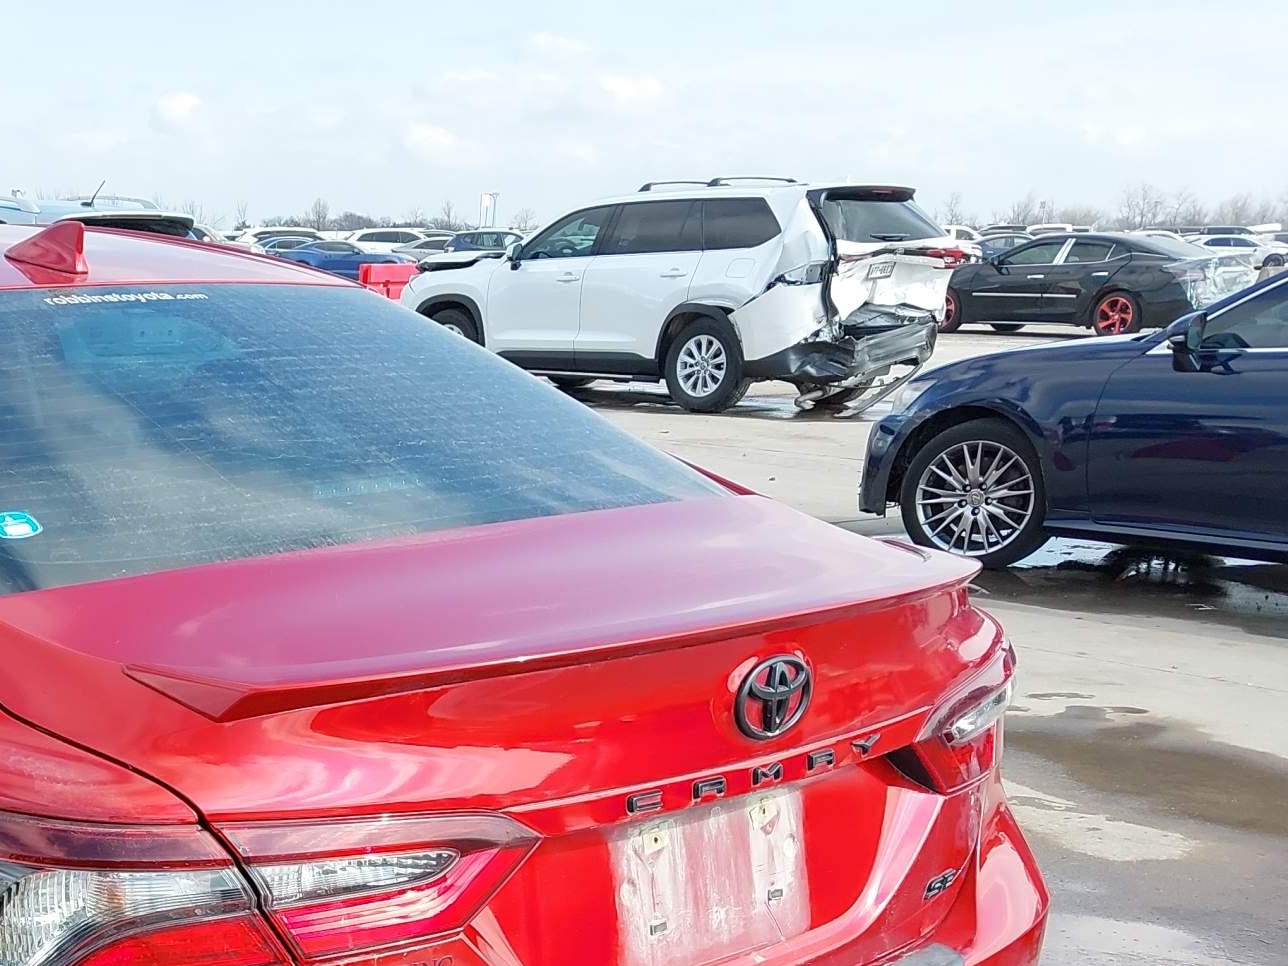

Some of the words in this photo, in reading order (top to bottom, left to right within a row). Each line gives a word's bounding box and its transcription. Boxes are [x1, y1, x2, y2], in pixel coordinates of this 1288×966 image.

[44, 291, 209, 305] robbinstoyota.com
[627, 733, 881, 814] CAMRY
[923, 867, 957, 901] SE
